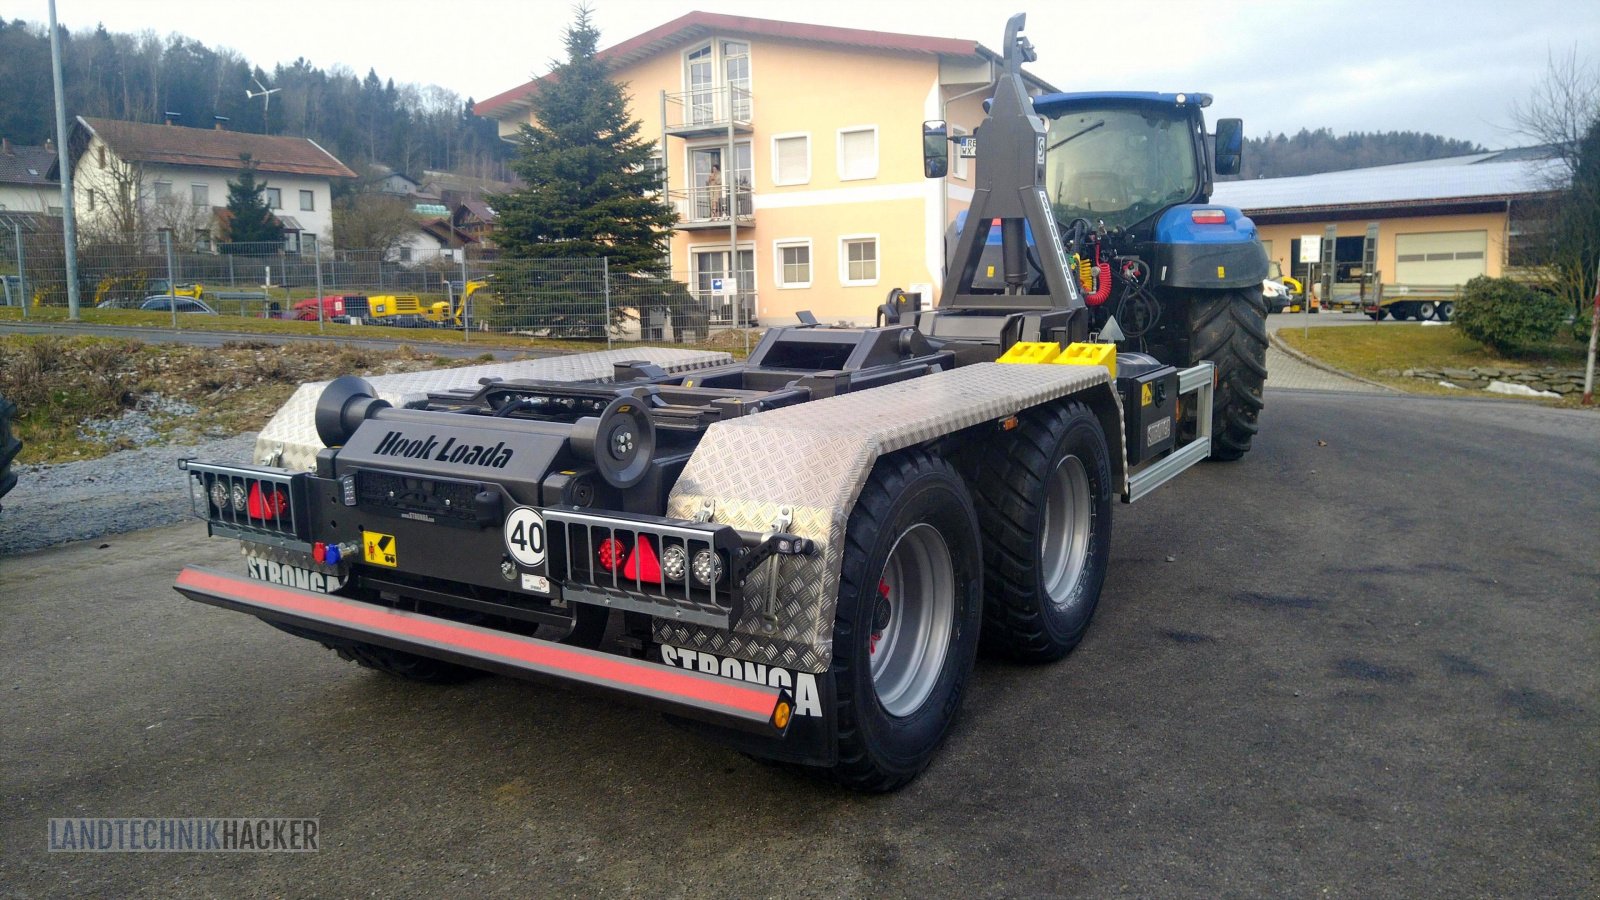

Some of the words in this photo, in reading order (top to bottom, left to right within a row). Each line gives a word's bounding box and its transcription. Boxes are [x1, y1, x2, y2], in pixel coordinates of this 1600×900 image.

[373, 431, 438, 460] Hook
[435, 437, 513, 468] Loada
[510, 520, 545, 554] 40
